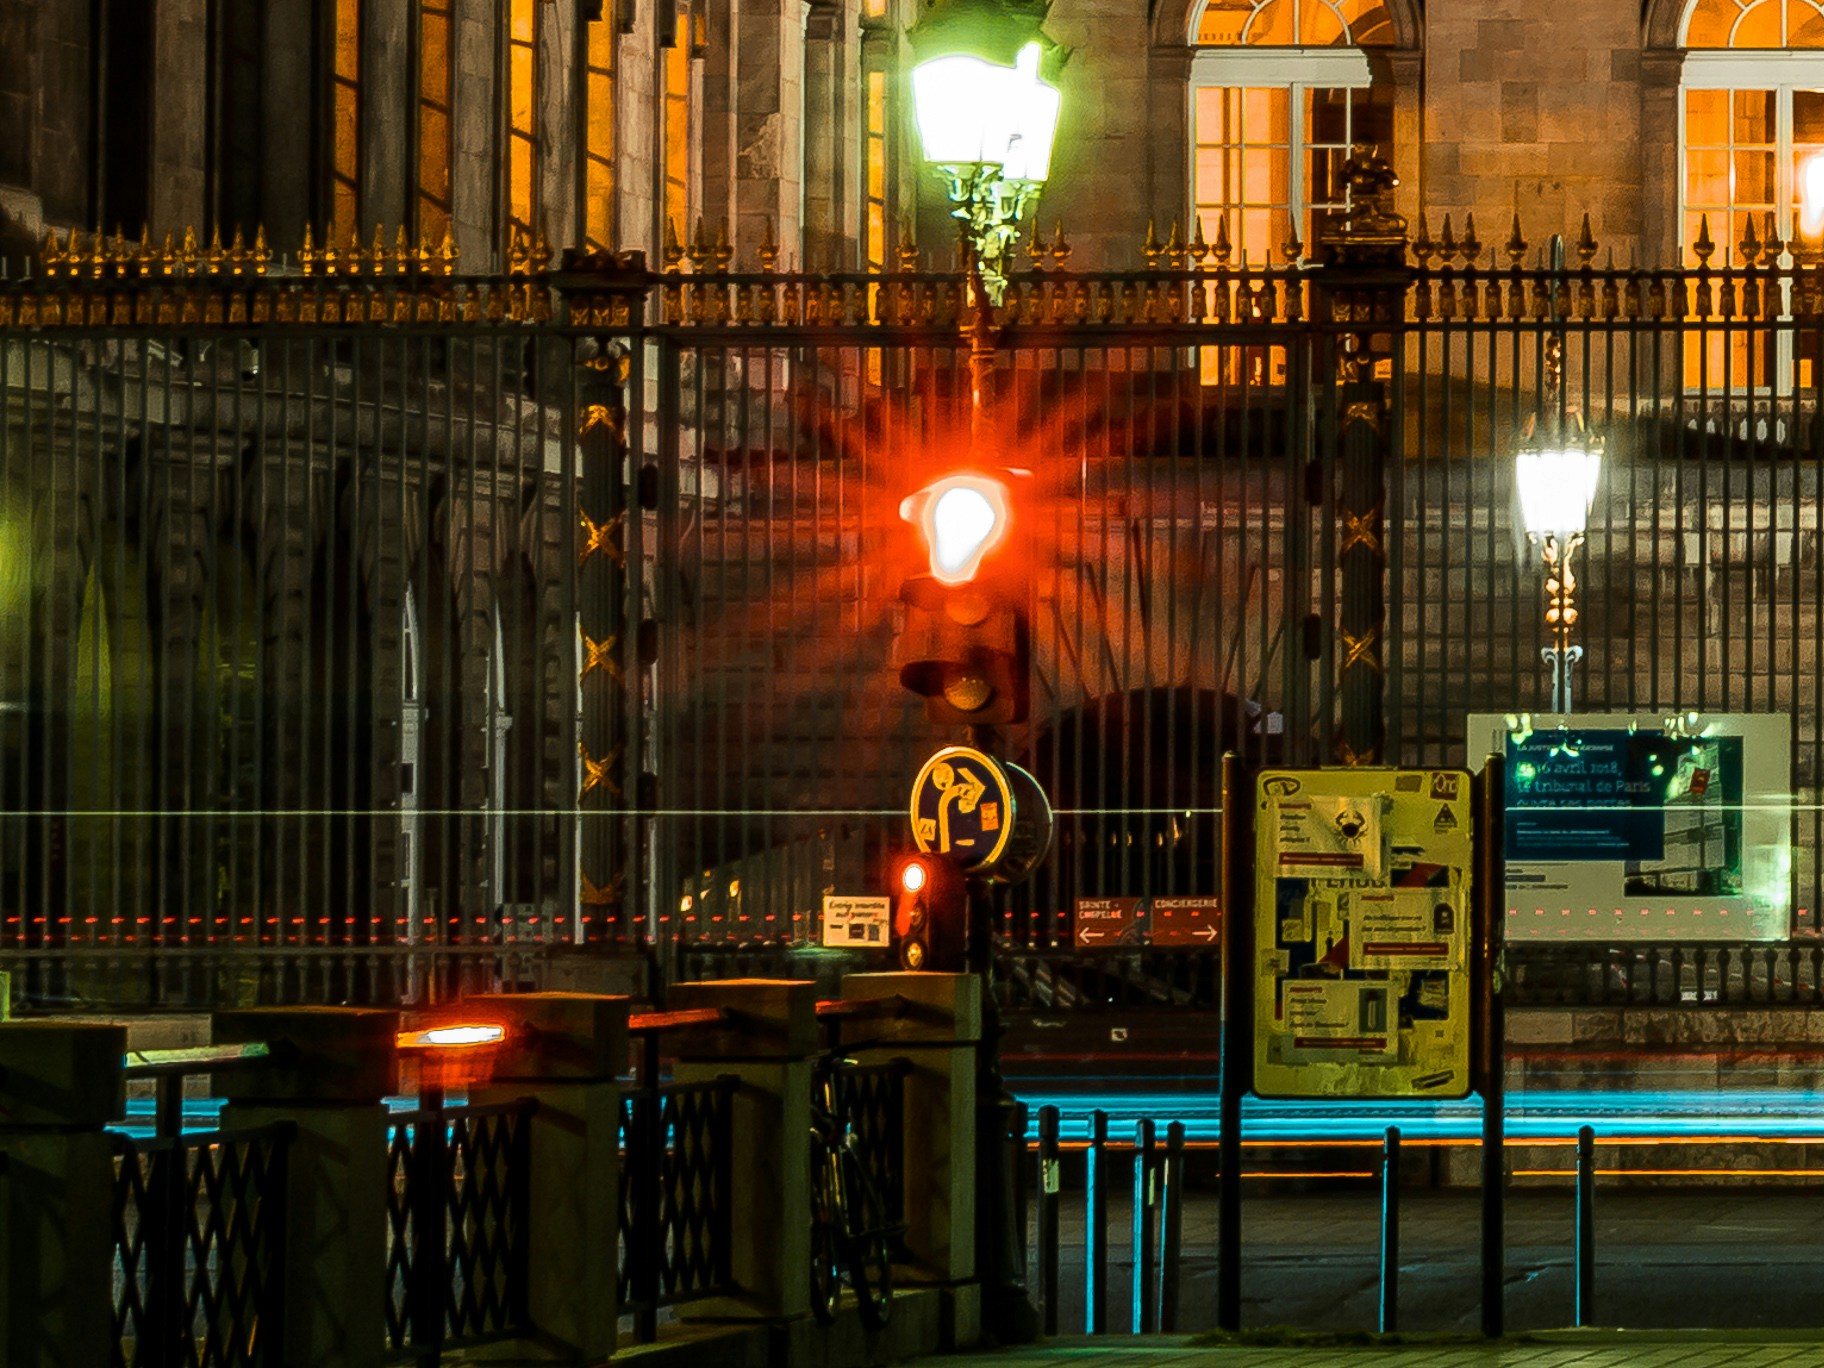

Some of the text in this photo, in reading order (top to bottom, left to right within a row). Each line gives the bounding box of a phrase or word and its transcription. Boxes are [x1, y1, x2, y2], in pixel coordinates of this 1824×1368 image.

[1553, 761, 1588, 775] avril
[1533, 779, 1592, 793] tribunal
[1595, 779, 1613, 793] de
[1615, 779, 1651, 793] Paris
